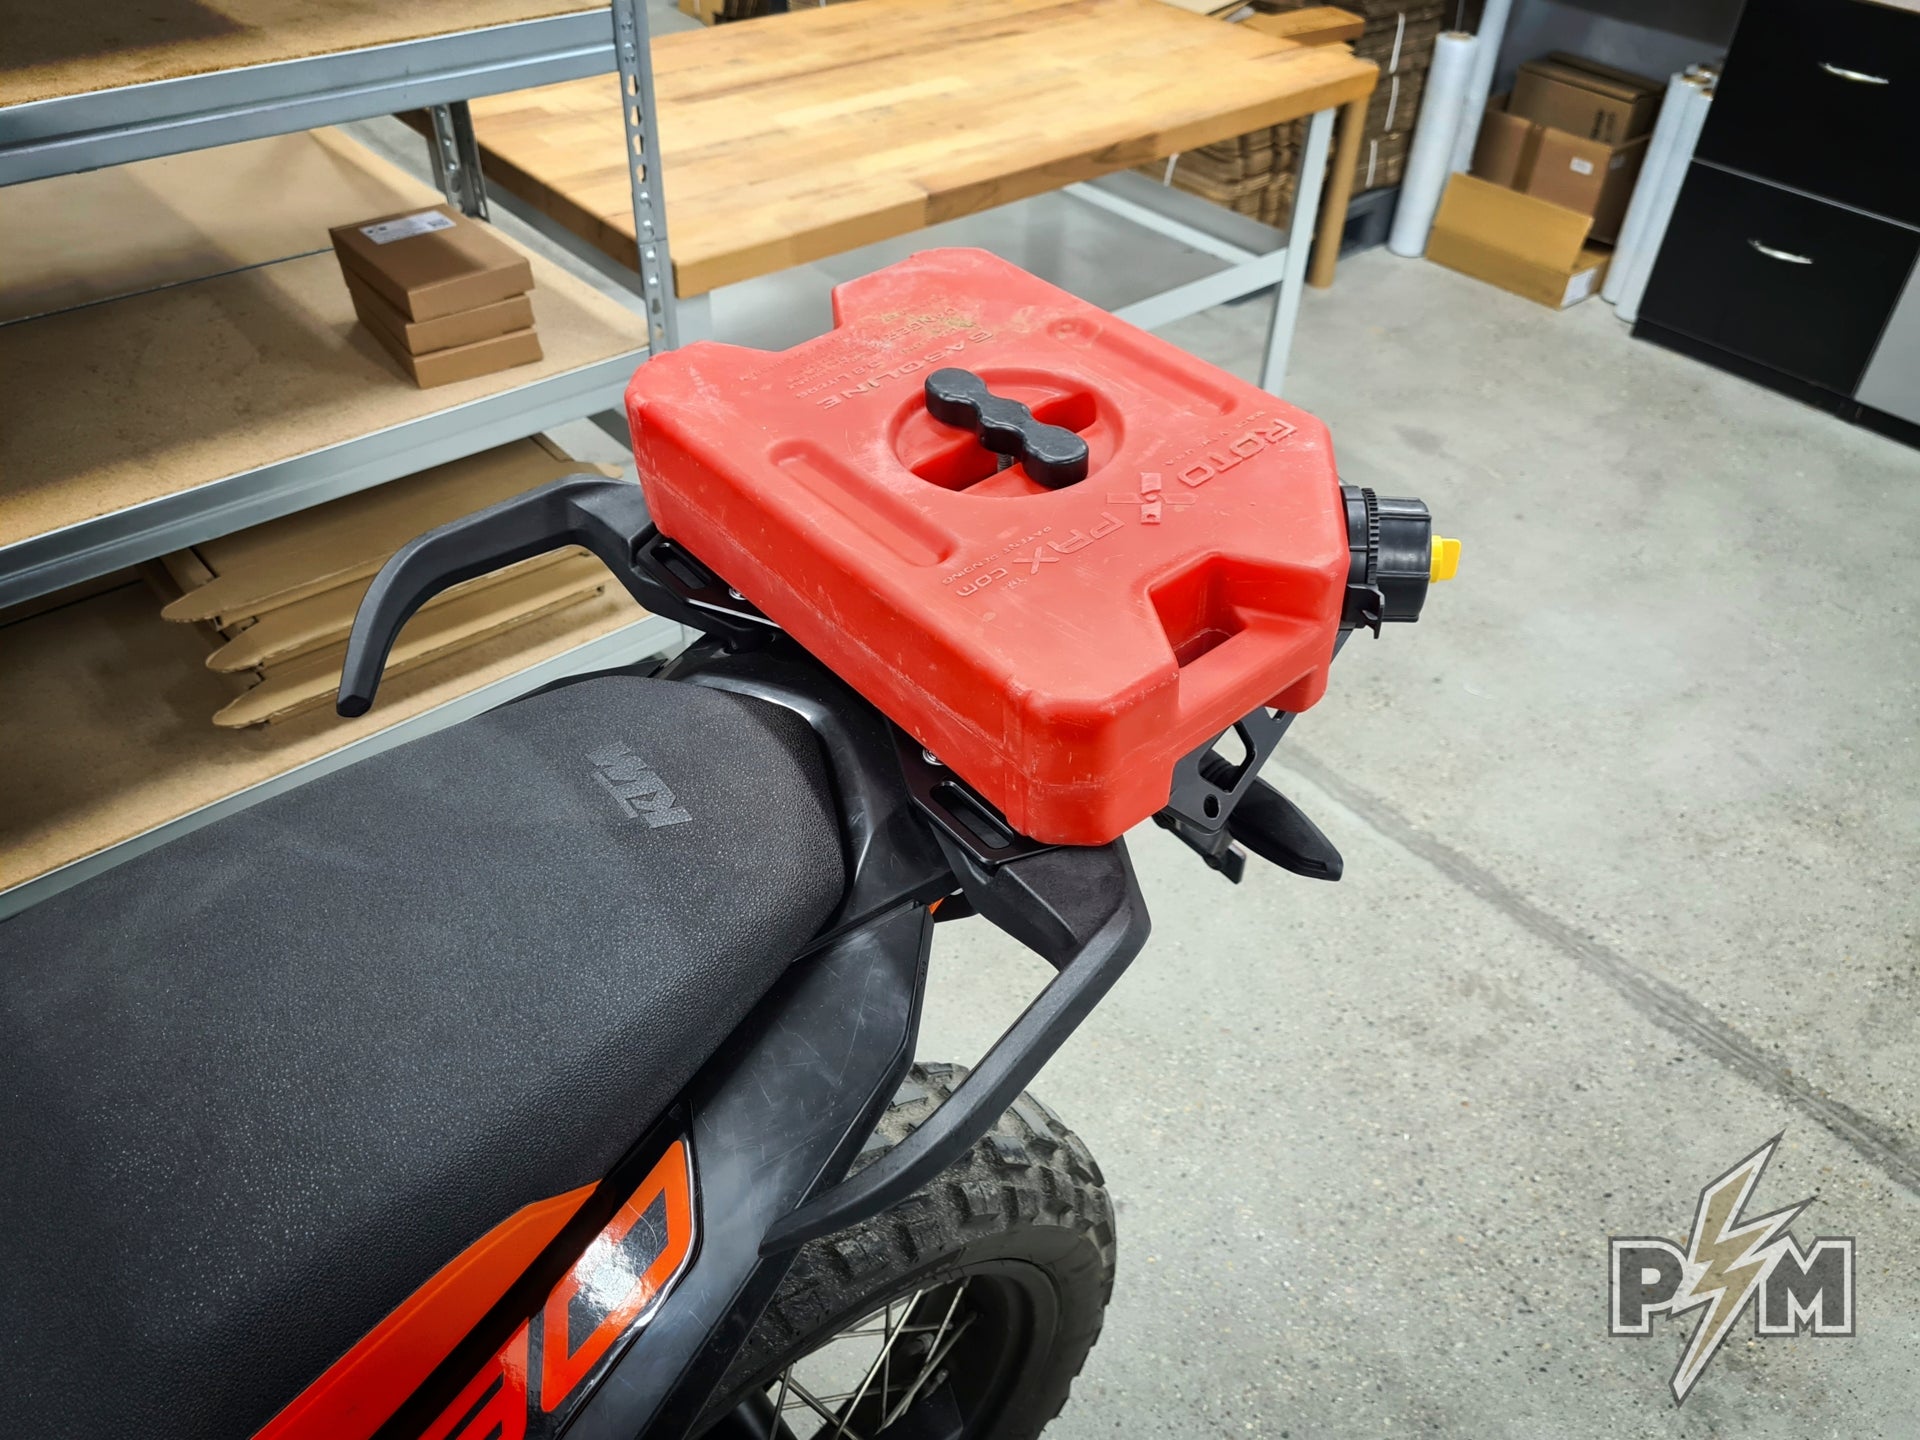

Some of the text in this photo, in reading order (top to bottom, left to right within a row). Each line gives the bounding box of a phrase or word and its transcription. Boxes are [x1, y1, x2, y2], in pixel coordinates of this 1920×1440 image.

[816, 330, 994, 410] GASOLINE
[1177, 418, 1297, 488] ROTO
[1011, 511, 1126, 575] PAX
[584, 741, 693, 829] KTM
